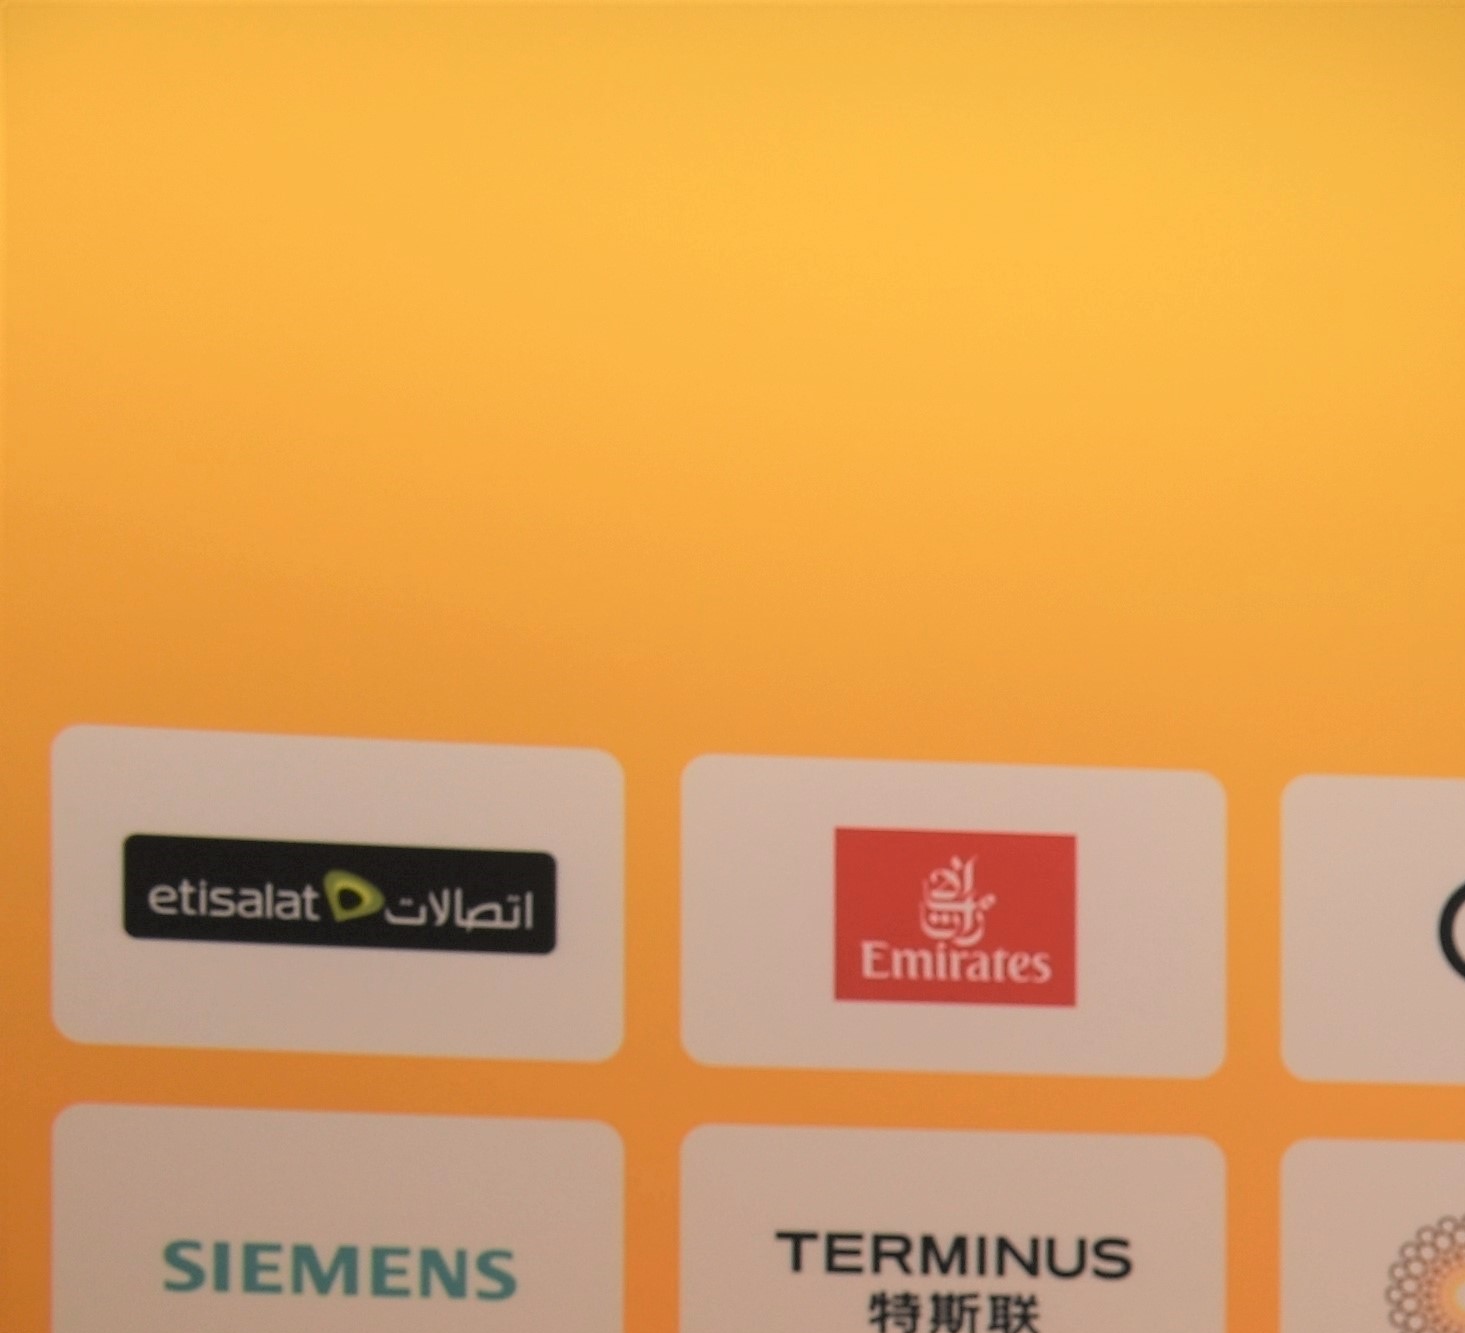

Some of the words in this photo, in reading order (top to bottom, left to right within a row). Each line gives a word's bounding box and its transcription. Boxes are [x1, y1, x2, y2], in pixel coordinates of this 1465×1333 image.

[148, 879, 320, 921] etisalat
[385, 888, 533, 931] اتصالات
[862, 940, 1051, 982] Emirates
[163, 1240, 516, 1301] SIEMENS
[776, 1231, 1132, 1280] TERMINUS
